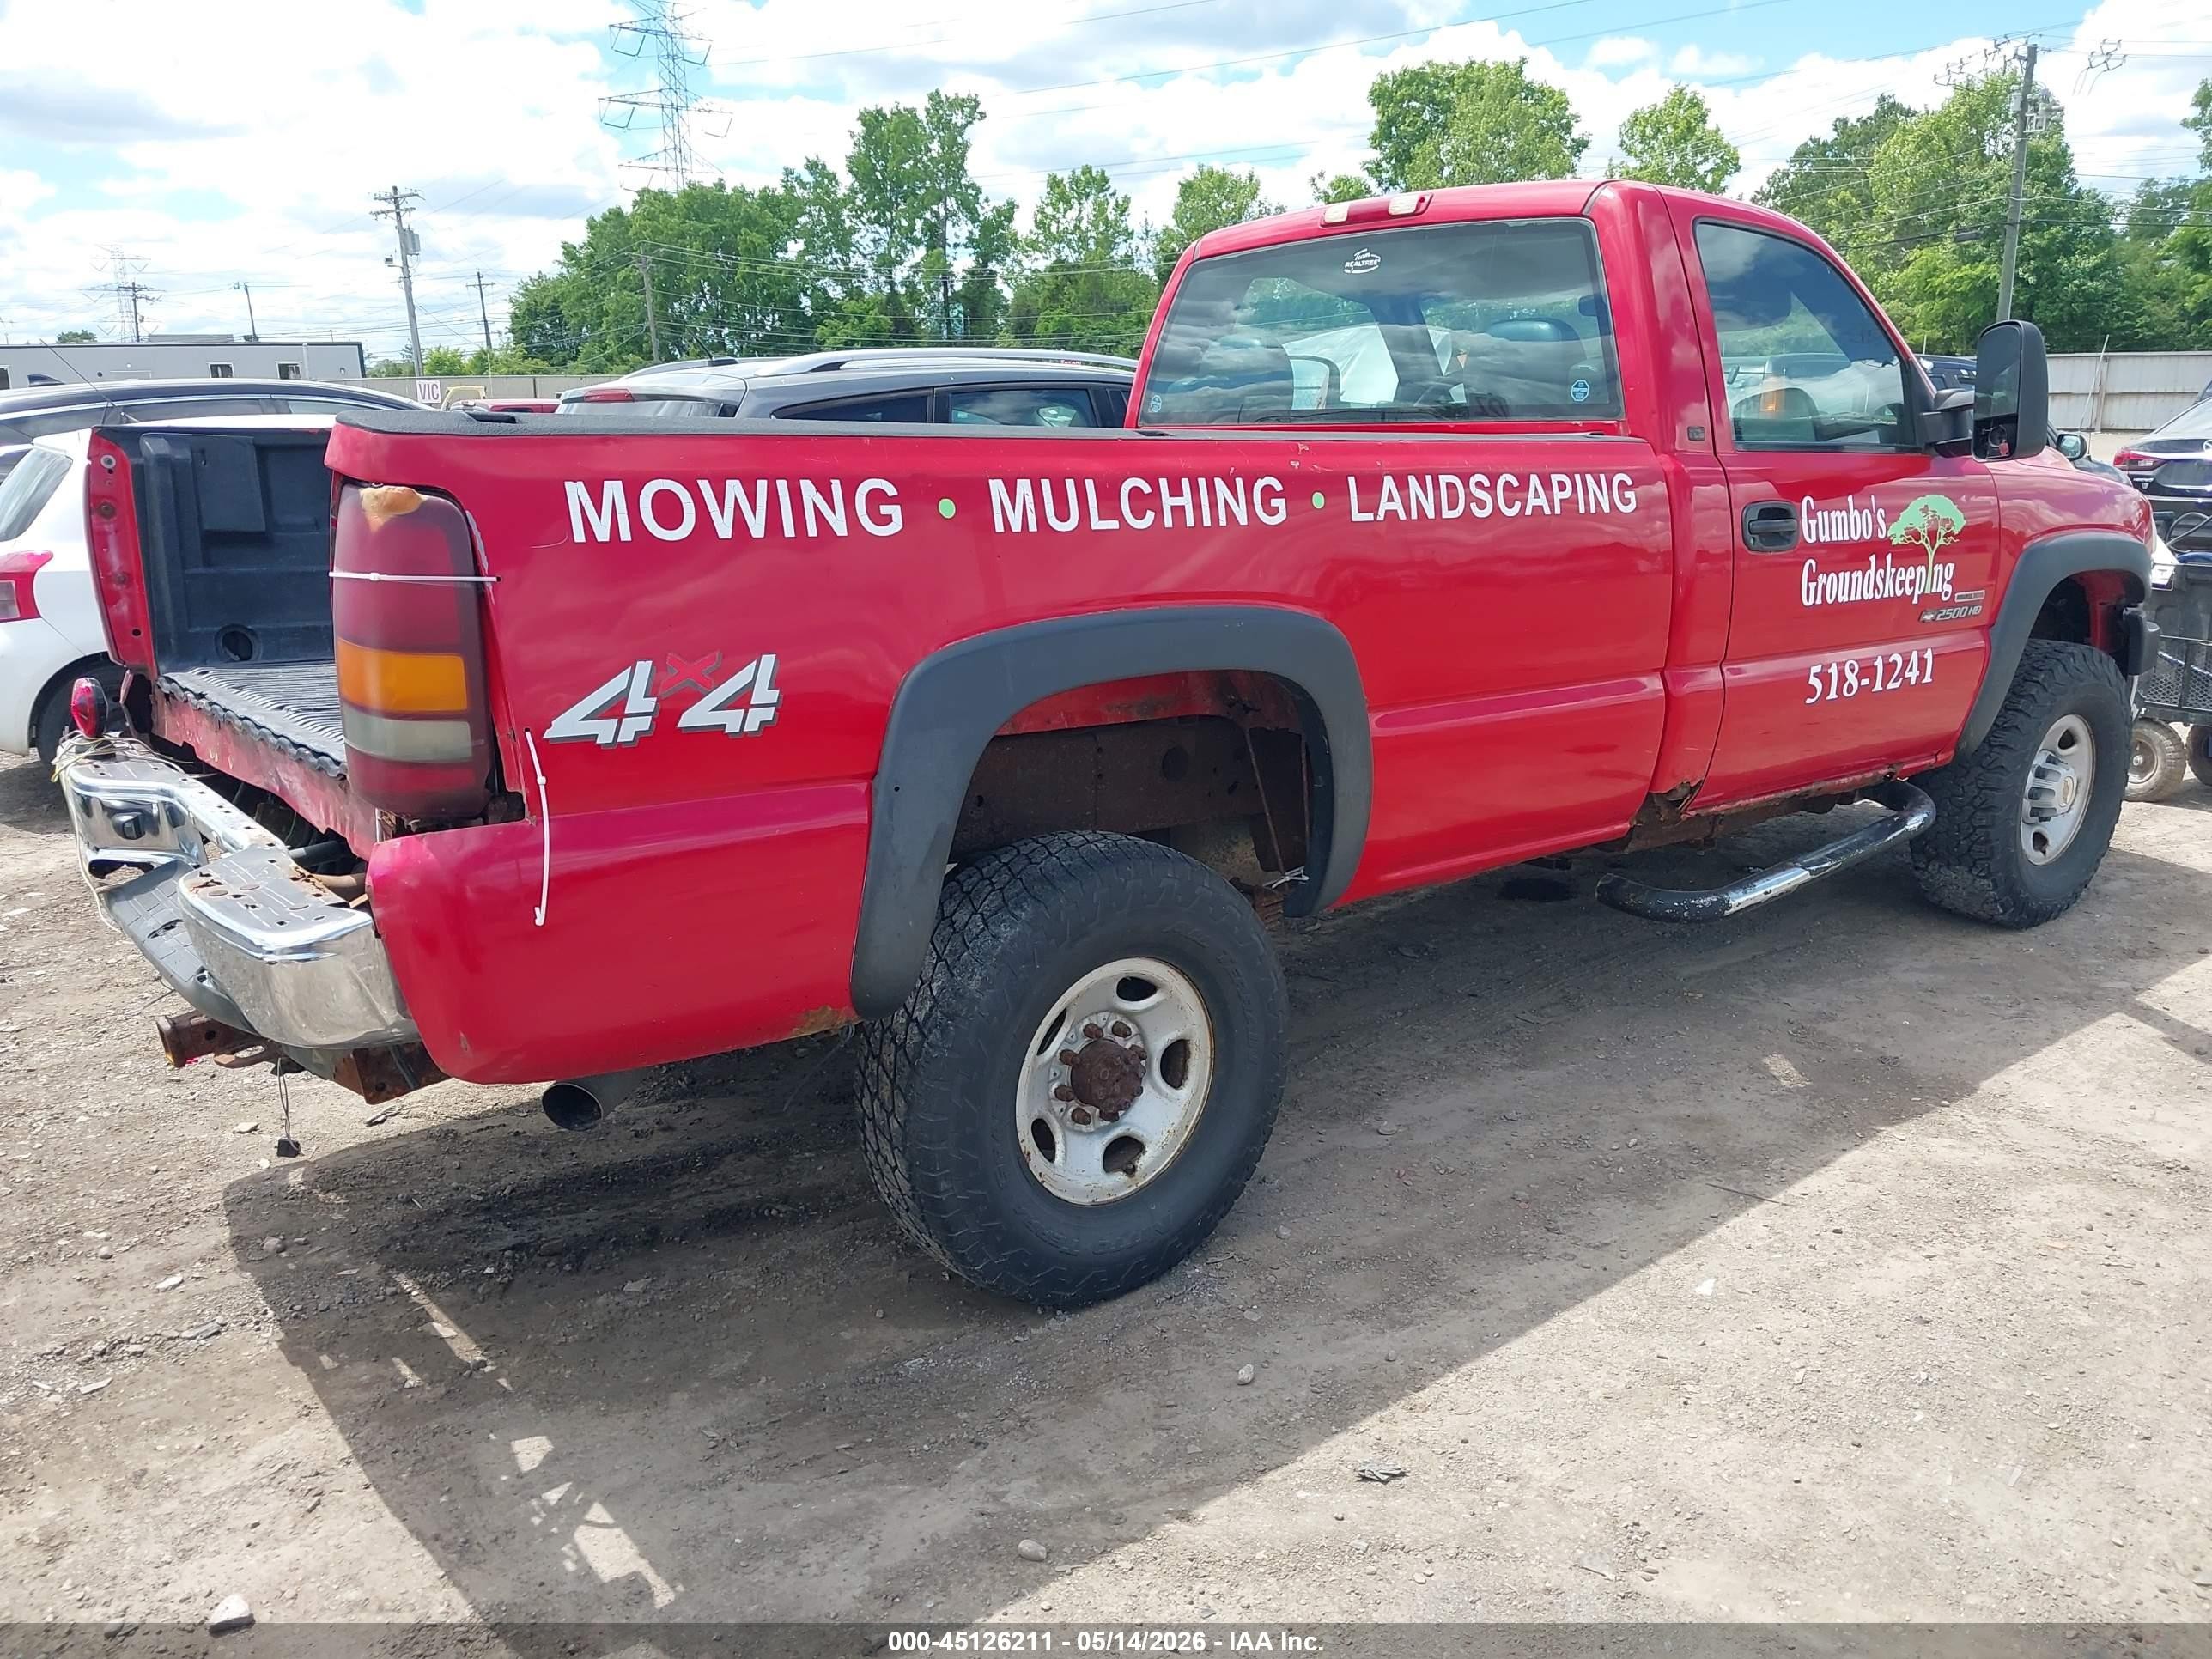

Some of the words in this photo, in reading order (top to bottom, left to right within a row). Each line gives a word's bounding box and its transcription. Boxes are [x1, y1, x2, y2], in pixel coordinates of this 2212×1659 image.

[418, 383, 440, 400] VIC
[562, 477, 904, 544] MOWING
[988, 476, 1288, 533] MULCHING
[1346, 472, 1638, 523] LANDSCAPING
[1801, 494, 1887, 544] Gumbo's
[1801, 552, 1955, 606] Groundskeeping
[1805, 647, 1934, 704] 518-1241
